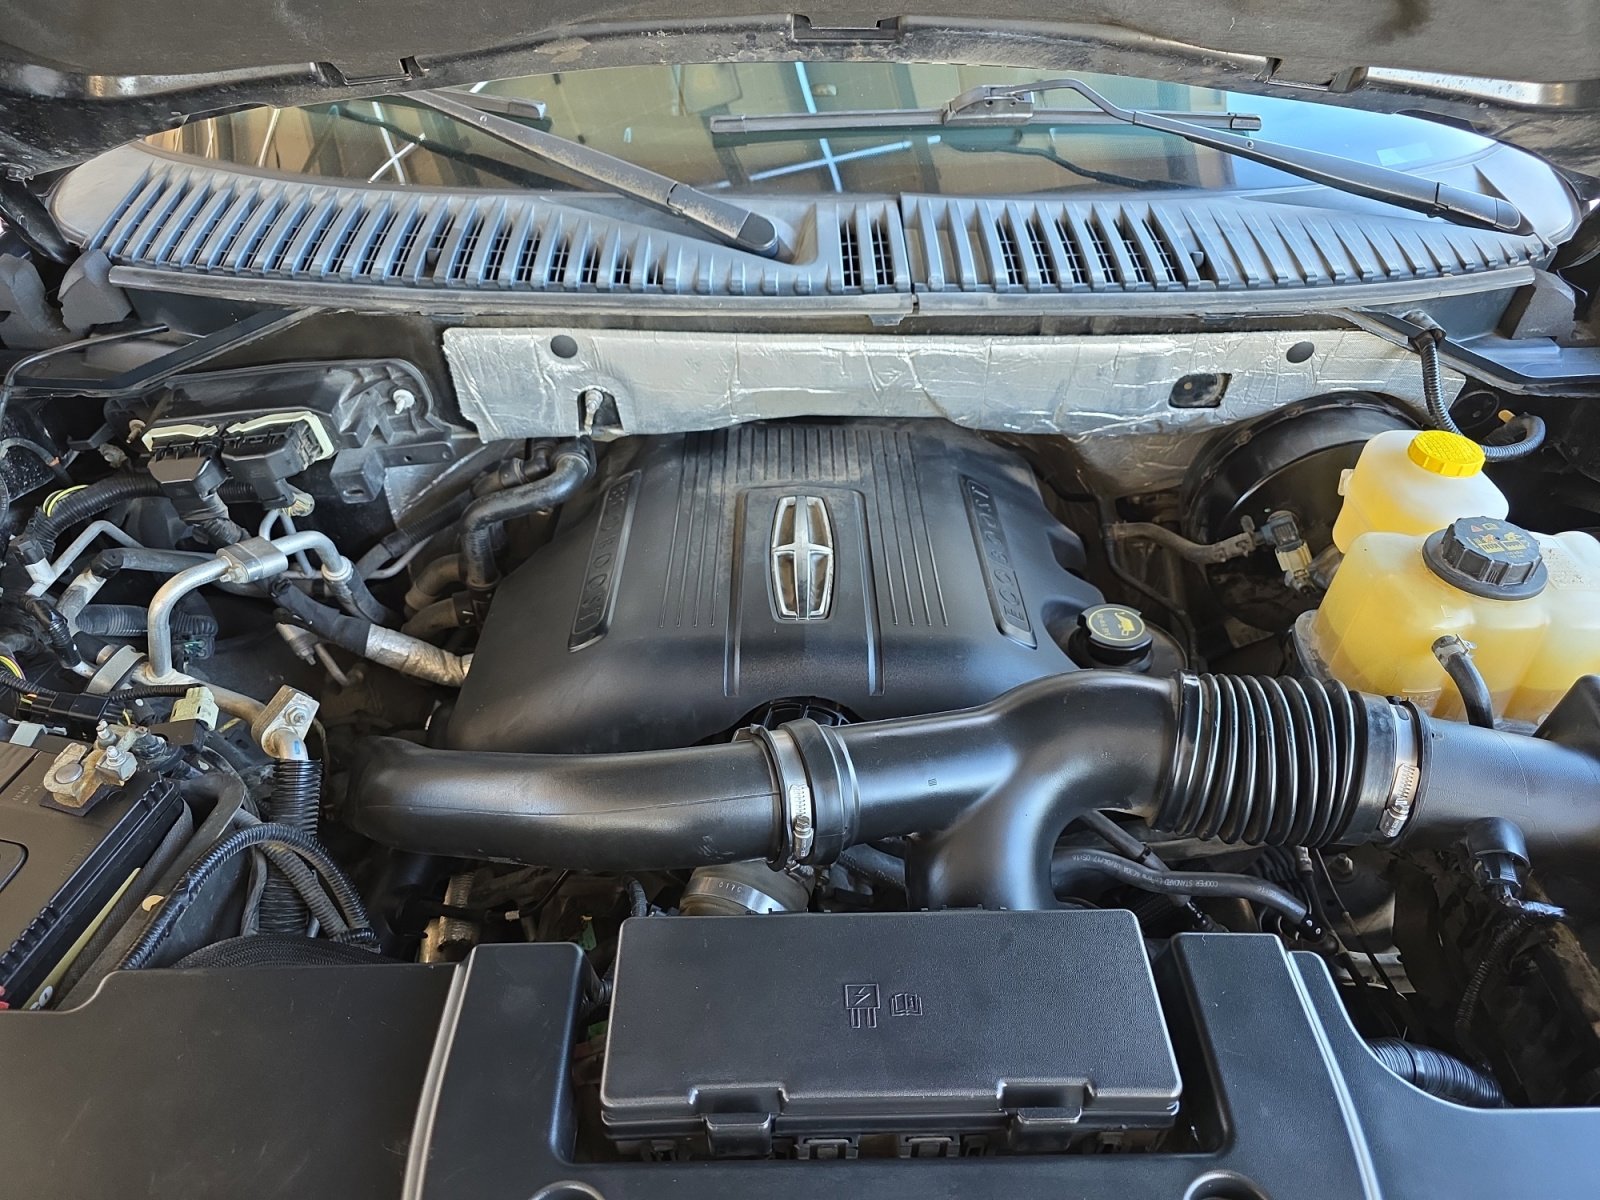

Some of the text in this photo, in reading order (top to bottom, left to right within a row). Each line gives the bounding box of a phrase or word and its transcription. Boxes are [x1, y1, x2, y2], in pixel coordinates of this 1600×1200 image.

[971, 485, 1025, 622] ECOBOOST
[1164, 878, 1194, 889] STANDARD
[1195, 879, 1219, 889] COOPER
